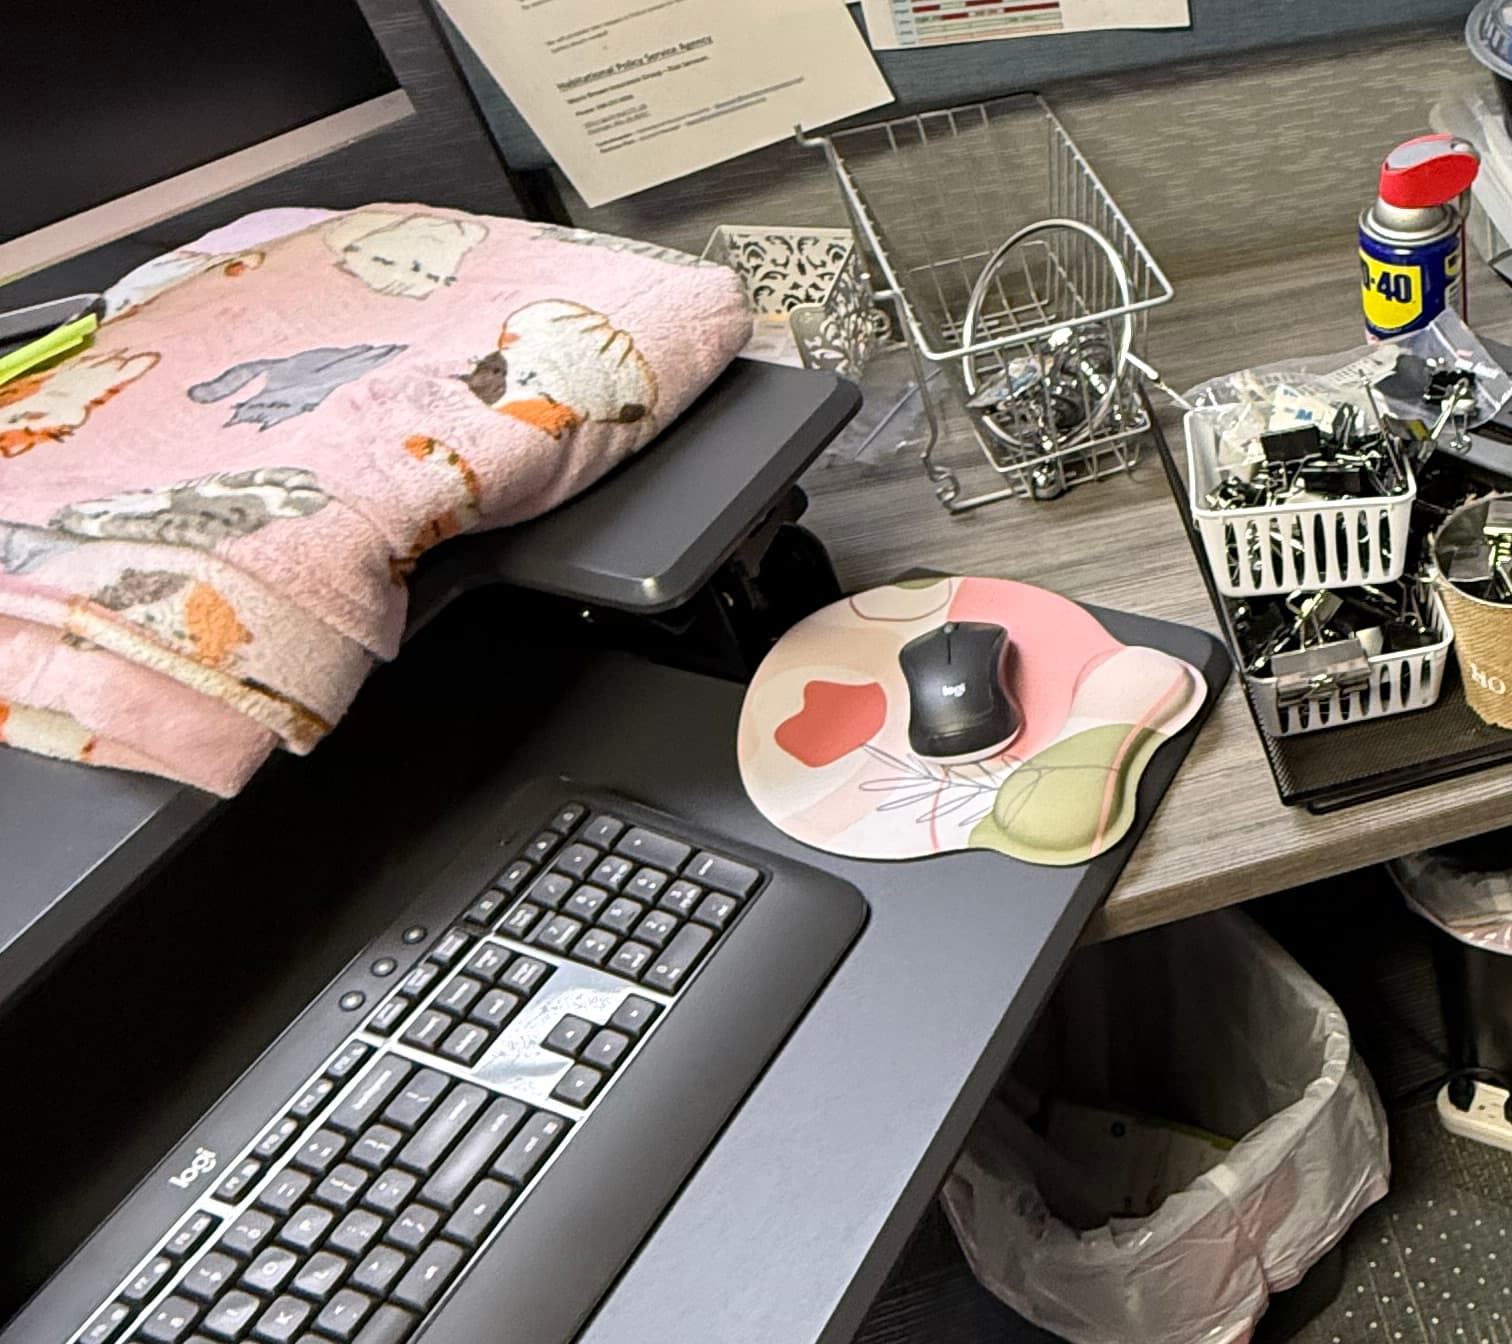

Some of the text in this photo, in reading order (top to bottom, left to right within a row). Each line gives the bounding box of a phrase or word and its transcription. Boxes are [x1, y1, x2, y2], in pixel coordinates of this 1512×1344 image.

[1469, 662, 1506, 694] HO
[168, 1147, 217, 1188] logi
[274, 1312, 293, 1325] K
